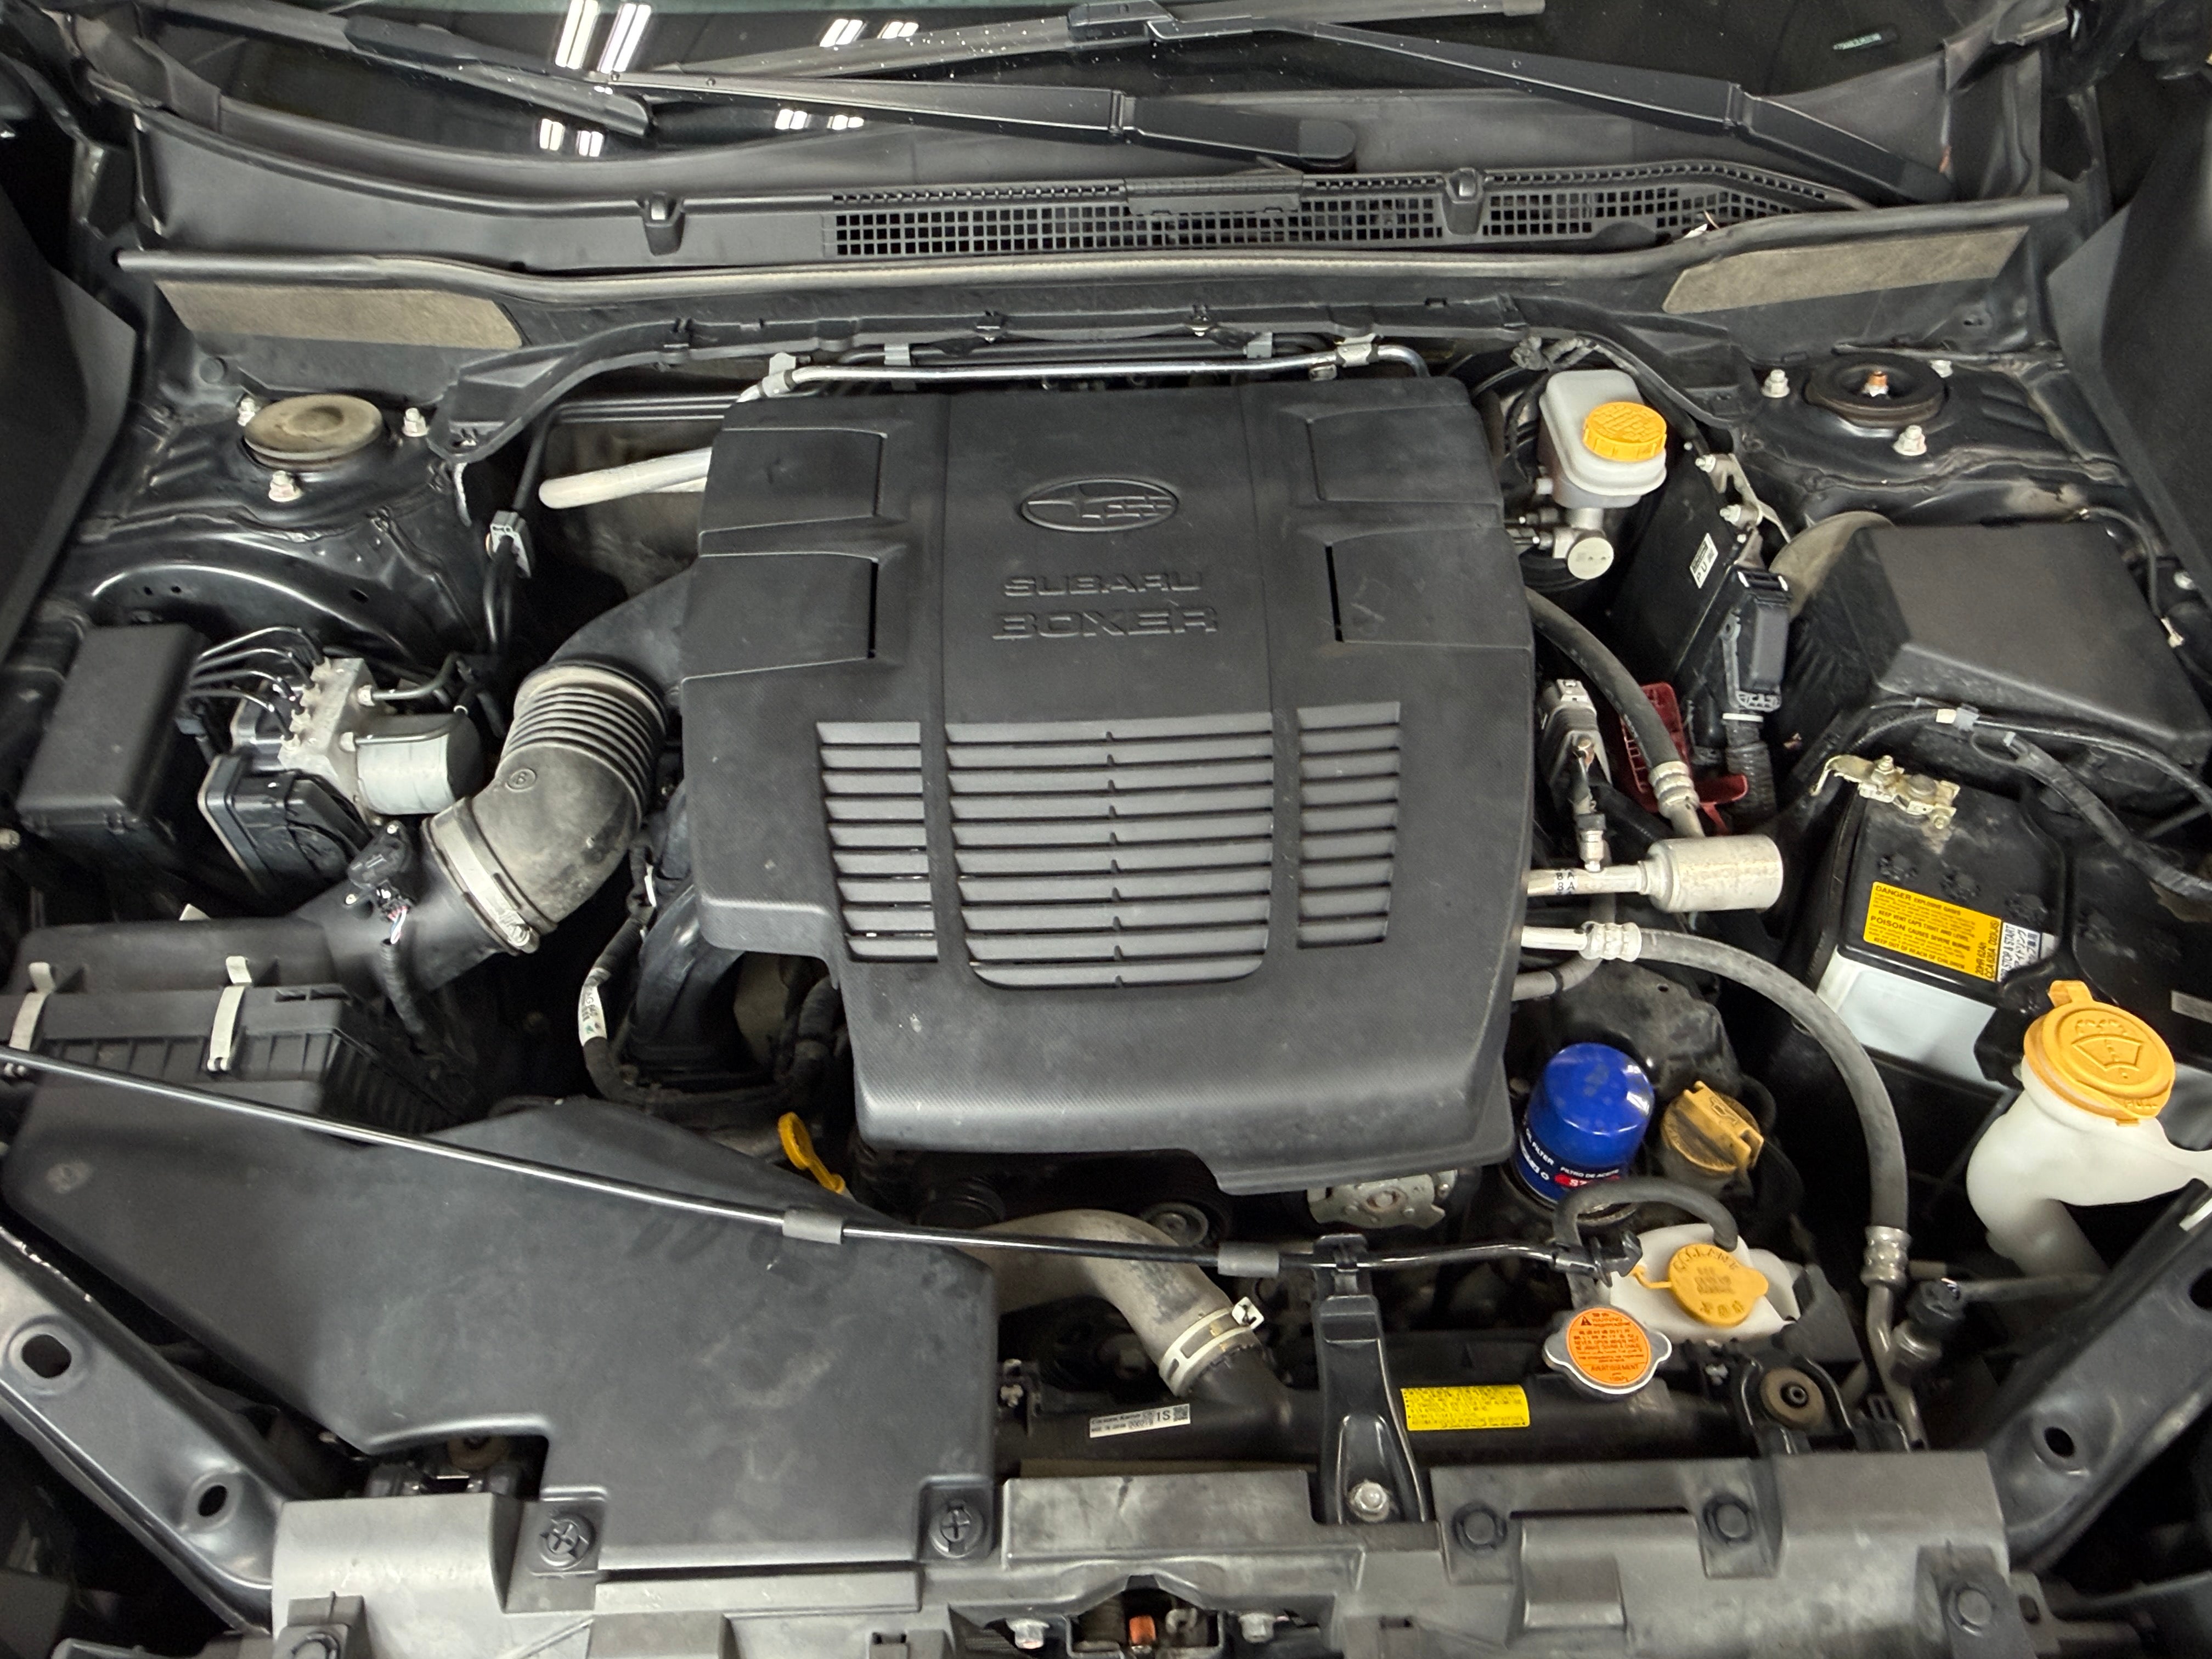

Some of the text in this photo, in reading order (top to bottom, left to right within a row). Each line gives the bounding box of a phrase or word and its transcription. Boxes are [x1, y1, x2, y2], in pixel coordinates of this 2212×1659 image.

[1004, 571, 1203, 597] SUBARU
[992, 606, 1219, 640] BOXER
[1875, 885, 1912, 901] DANGER
[1870, 915, 1906, 932] POISON
[2004, 924, 2016, 946] START
[2001, 951, 2013, 969] STOP
[1532, 1141, 1555, 1166] FILTER
[1560, 1166, 1584, 1178] FILTRO
